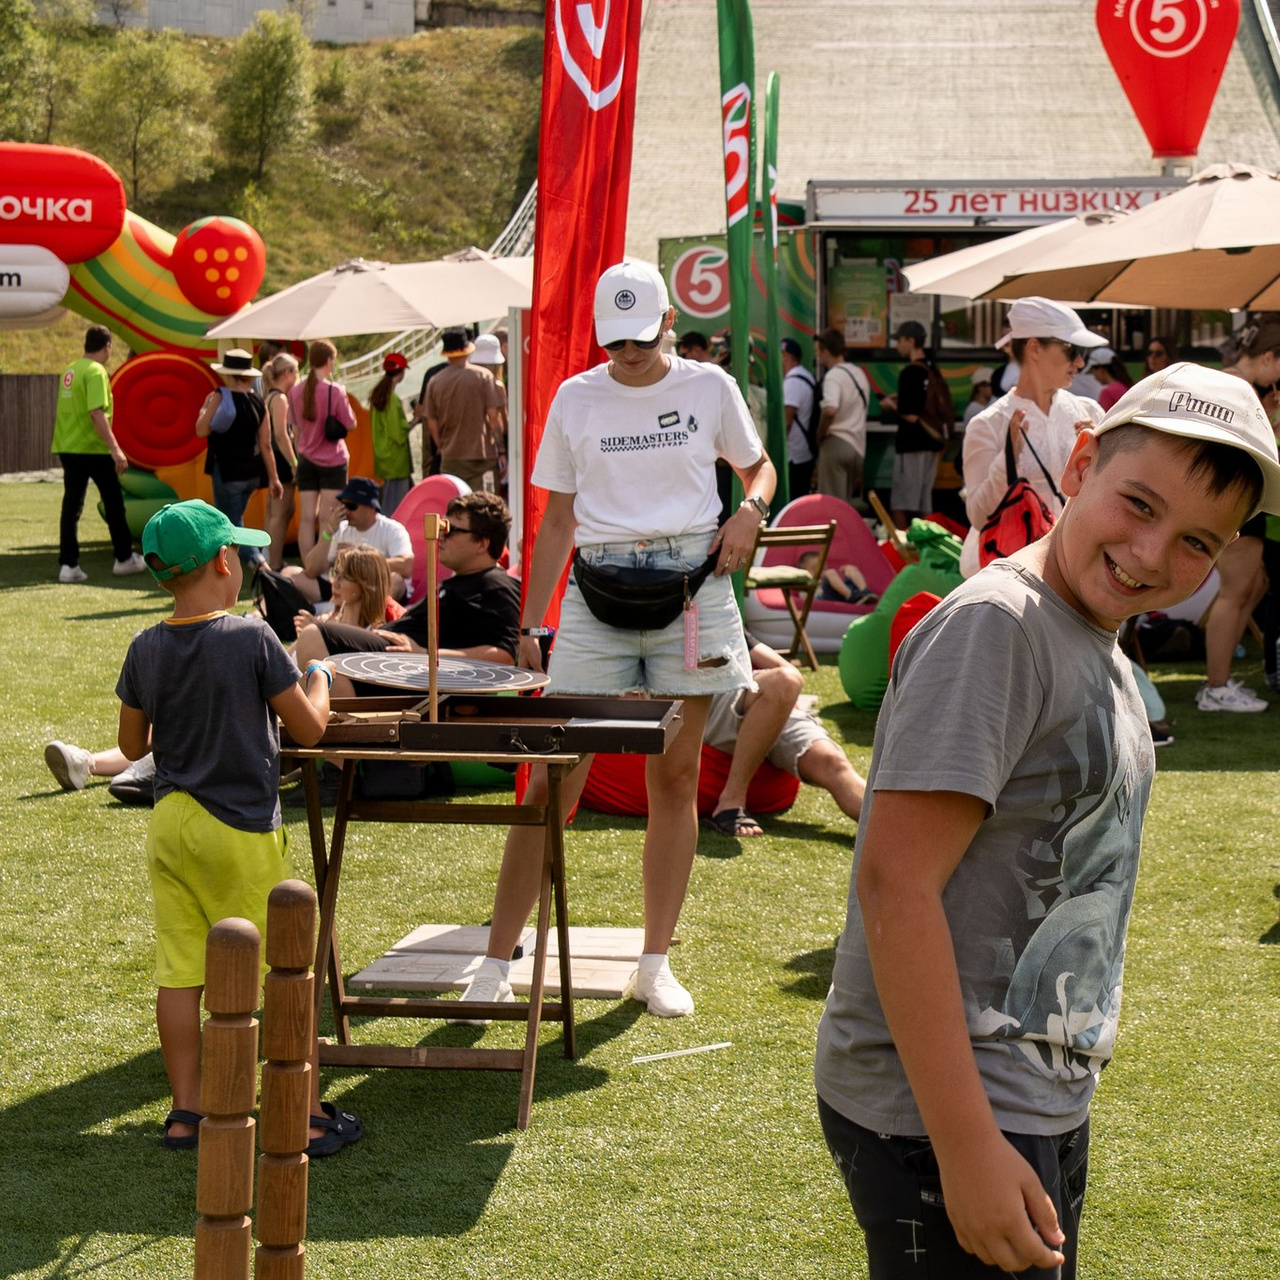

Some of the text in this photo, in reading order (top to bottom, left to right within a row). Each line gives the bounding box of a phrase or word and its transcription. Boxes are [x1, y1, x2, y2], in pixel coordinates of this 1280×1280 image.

[903, 189, 939, 215] 25
[947, 192, 1007, 214] лет
[688, 253, 728, 305] 5
[600, 431, 689, 447] SIDEMASTERS
